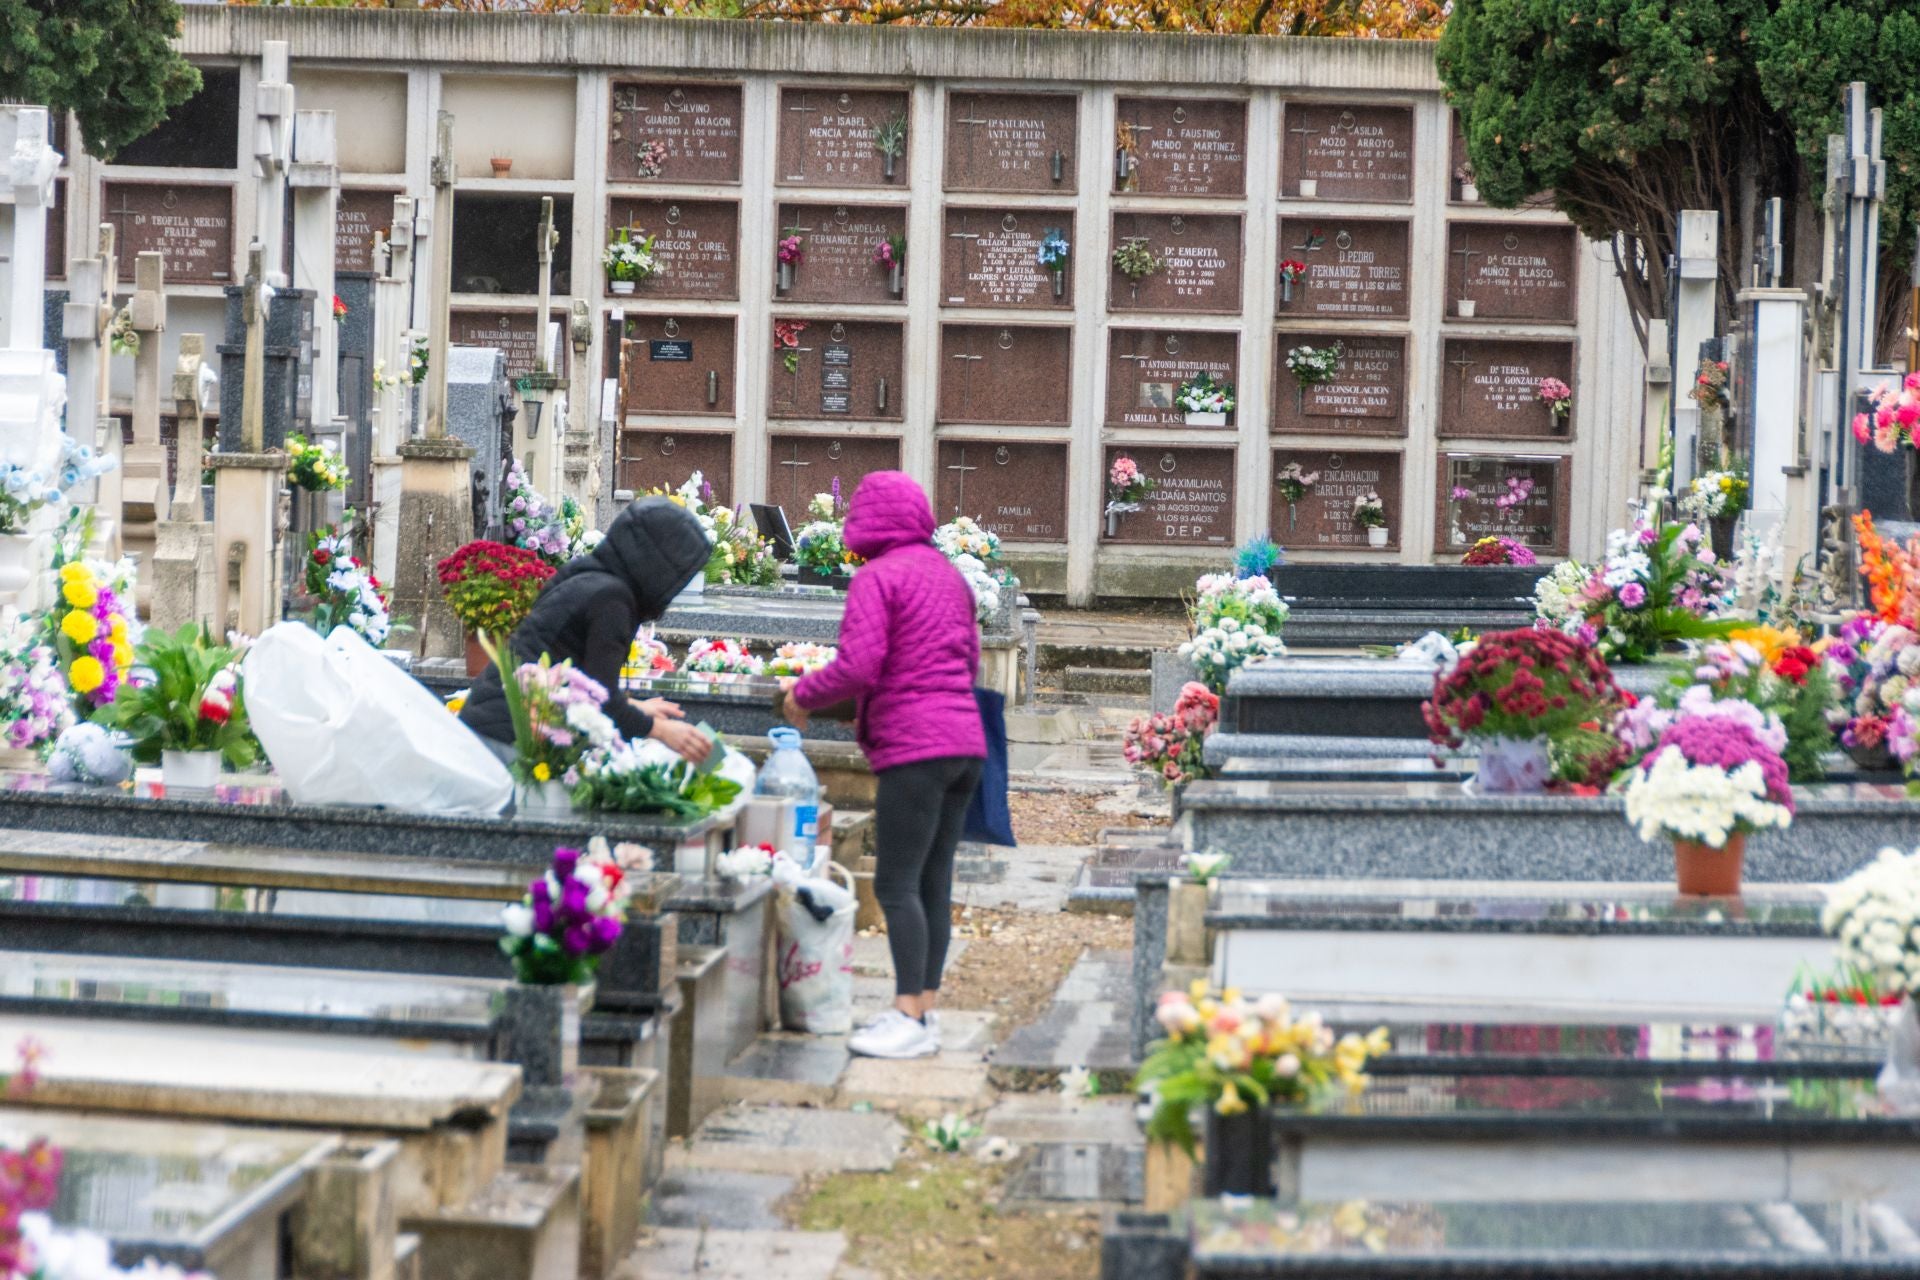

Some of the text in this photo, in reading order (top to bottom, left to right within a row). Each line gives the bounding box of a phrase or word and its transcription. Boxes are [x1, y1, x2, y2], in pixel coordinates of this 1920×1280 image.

[645, 116, 680, 125] GUARDO
[837, 116, 867, 127] ISABEL
[809, 128, 842, 138] MENCIA
[1180, 129, 1221, 139] FAUSTINO
[1151, 140, 1235, 152] MENDO MARTINEZ
[1320, 138, 1395, 148] MOZO ARROYO
[152, 216, 226, 227] TEOFILA MERINO
[165, 227, 197, 237] FRAILE
[677, 230, 697, 239] JUAN
[810, 235, 858, 245] FERNANDEZ
[698, 242, 727, 252] CURIEL
[1179, 247, 1218, 257] EMERITA
[1348, 251, 1374, 263] PEDRO
[1501, 256, 1547, 266] CELESTINA
[1197, 259, 1226, 269] CALVO
[1311, 264, 1400, 279] FERNANDEZ TORRES
[1480, 265, 1554, 278] MUÑOZ BLASCO
[1148, 360, 1177, 369] ANTONIO
[1209, 361, 1230, 370] BRASA
[1354, 362, 1389, 371] BLASCO
[1501, 366, 1530, 375] TERESA
[1474, 376, 1500, 384] GALLO
[1326, 385, 1390, 394] CONSOLACION
[1315, 395, 1387, 406] PERROTE ABAD
[1124, 413, 1157, 423] FAMILIA
[1324, 470, 1379, 482] ENCARNACION
[1163, 478, 1223, 489] MAXIMILIANA
[1189, 491, 1227, 503] SANTOS
[998, 506, 1032, 516] FAMILIA
[1167, 504, 1200, 512] AGOSTO
[1190, 514, 1213, 523] AÑOS
[1027, 524, 1052, 534] NIETO
